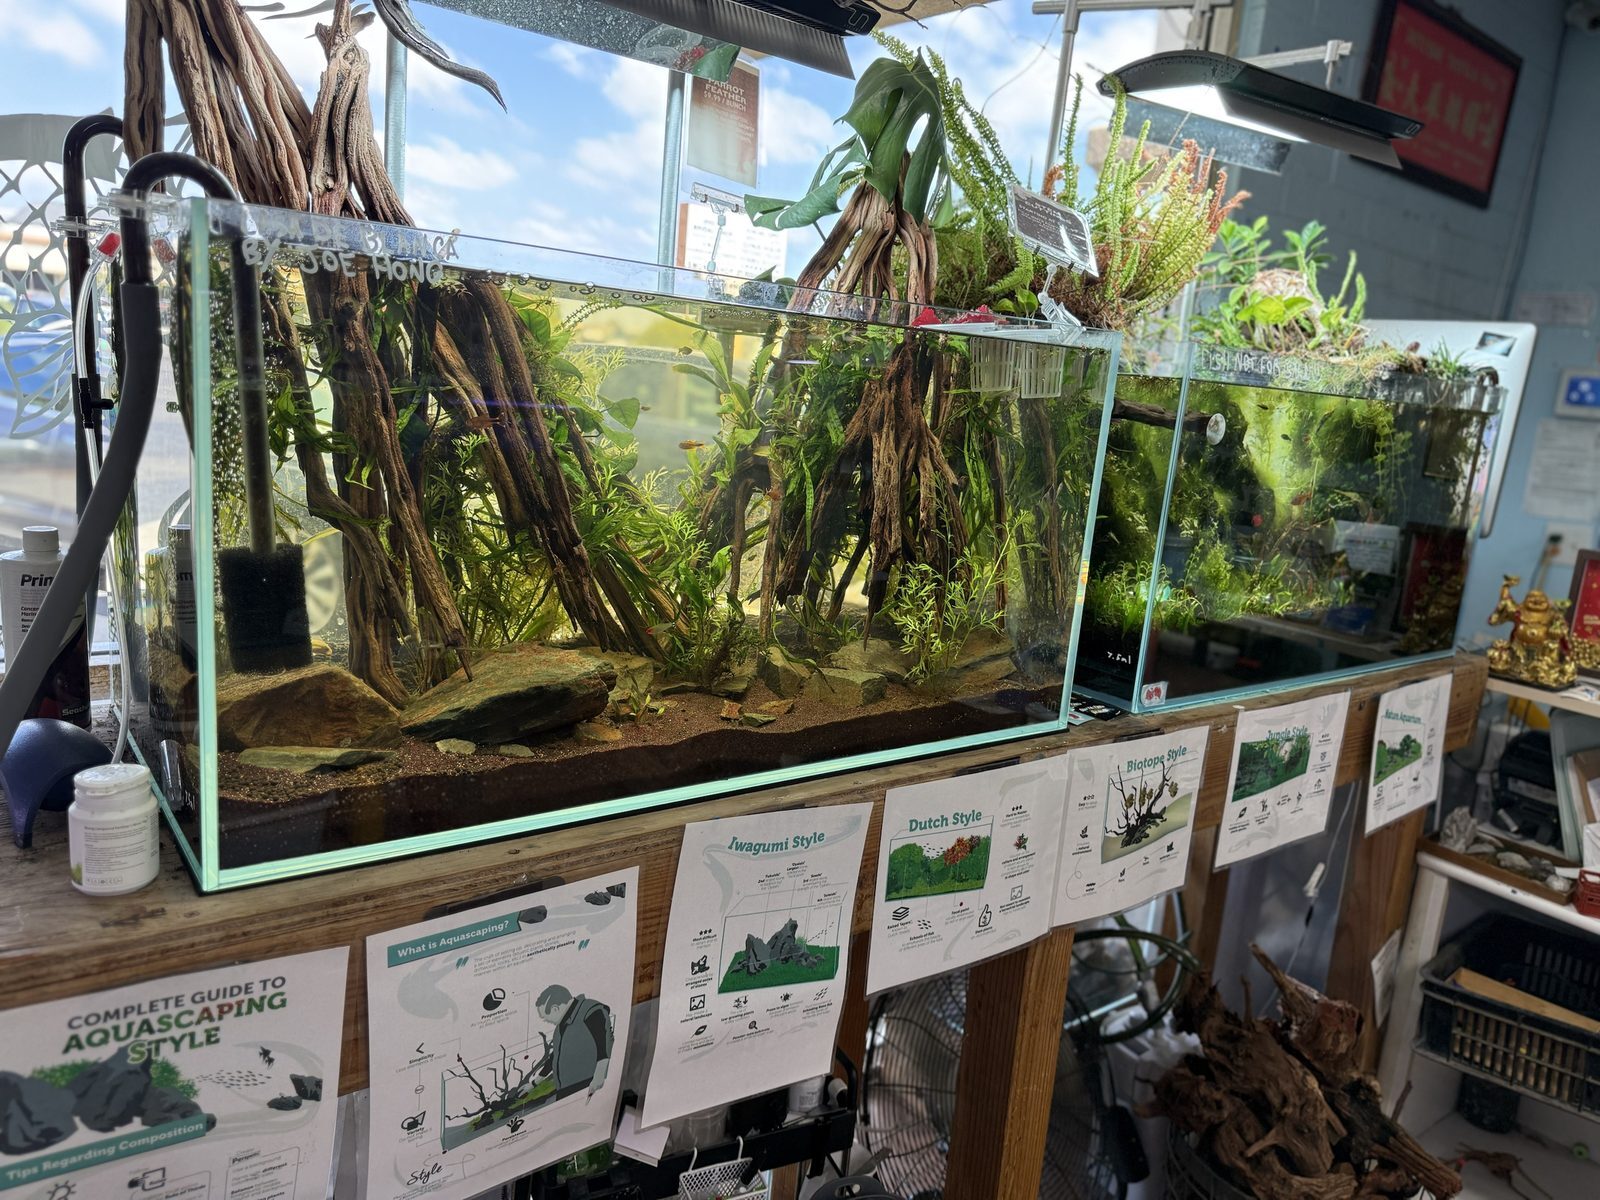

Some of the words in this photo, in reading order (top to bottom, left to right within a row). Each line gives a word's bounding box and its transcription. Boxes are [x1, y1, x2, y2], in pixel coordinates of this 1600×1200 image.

[705, 84, 747, 105] FEATHER
[708, 77, 745, 95] PARROT
[299, 244, 357, 277] JOE
[1126, 754, 1165, 773] Biotope
[1166, 745, 1187, 761] Style
[909, 813, 949, 832] Dutch
[952, 809, 982, 827] Style
[728, 836, 789, 855] Iwagumi
[792, 831, 825, 850] Style
[397, 941, 426, 959] What
[428, 939, 437, 951] is
[439, 920, 510, 948] Aquascaping?
[67, 993, 186, 1030] COMPLETE
[191, 981, 254, 1005] GUIDE
[258, 976, 287, 990] TO
[62, 992, 288, 1055] AQUASCAPING
[127, 1026, 221, 1064] STYLE
[6, 1164, 38, 1182] Tips
[42, 1144, 117, 1173] Regarding
[119, 1121, 204, 1152] Composition
[407, 1162, 443, 1186] Style
